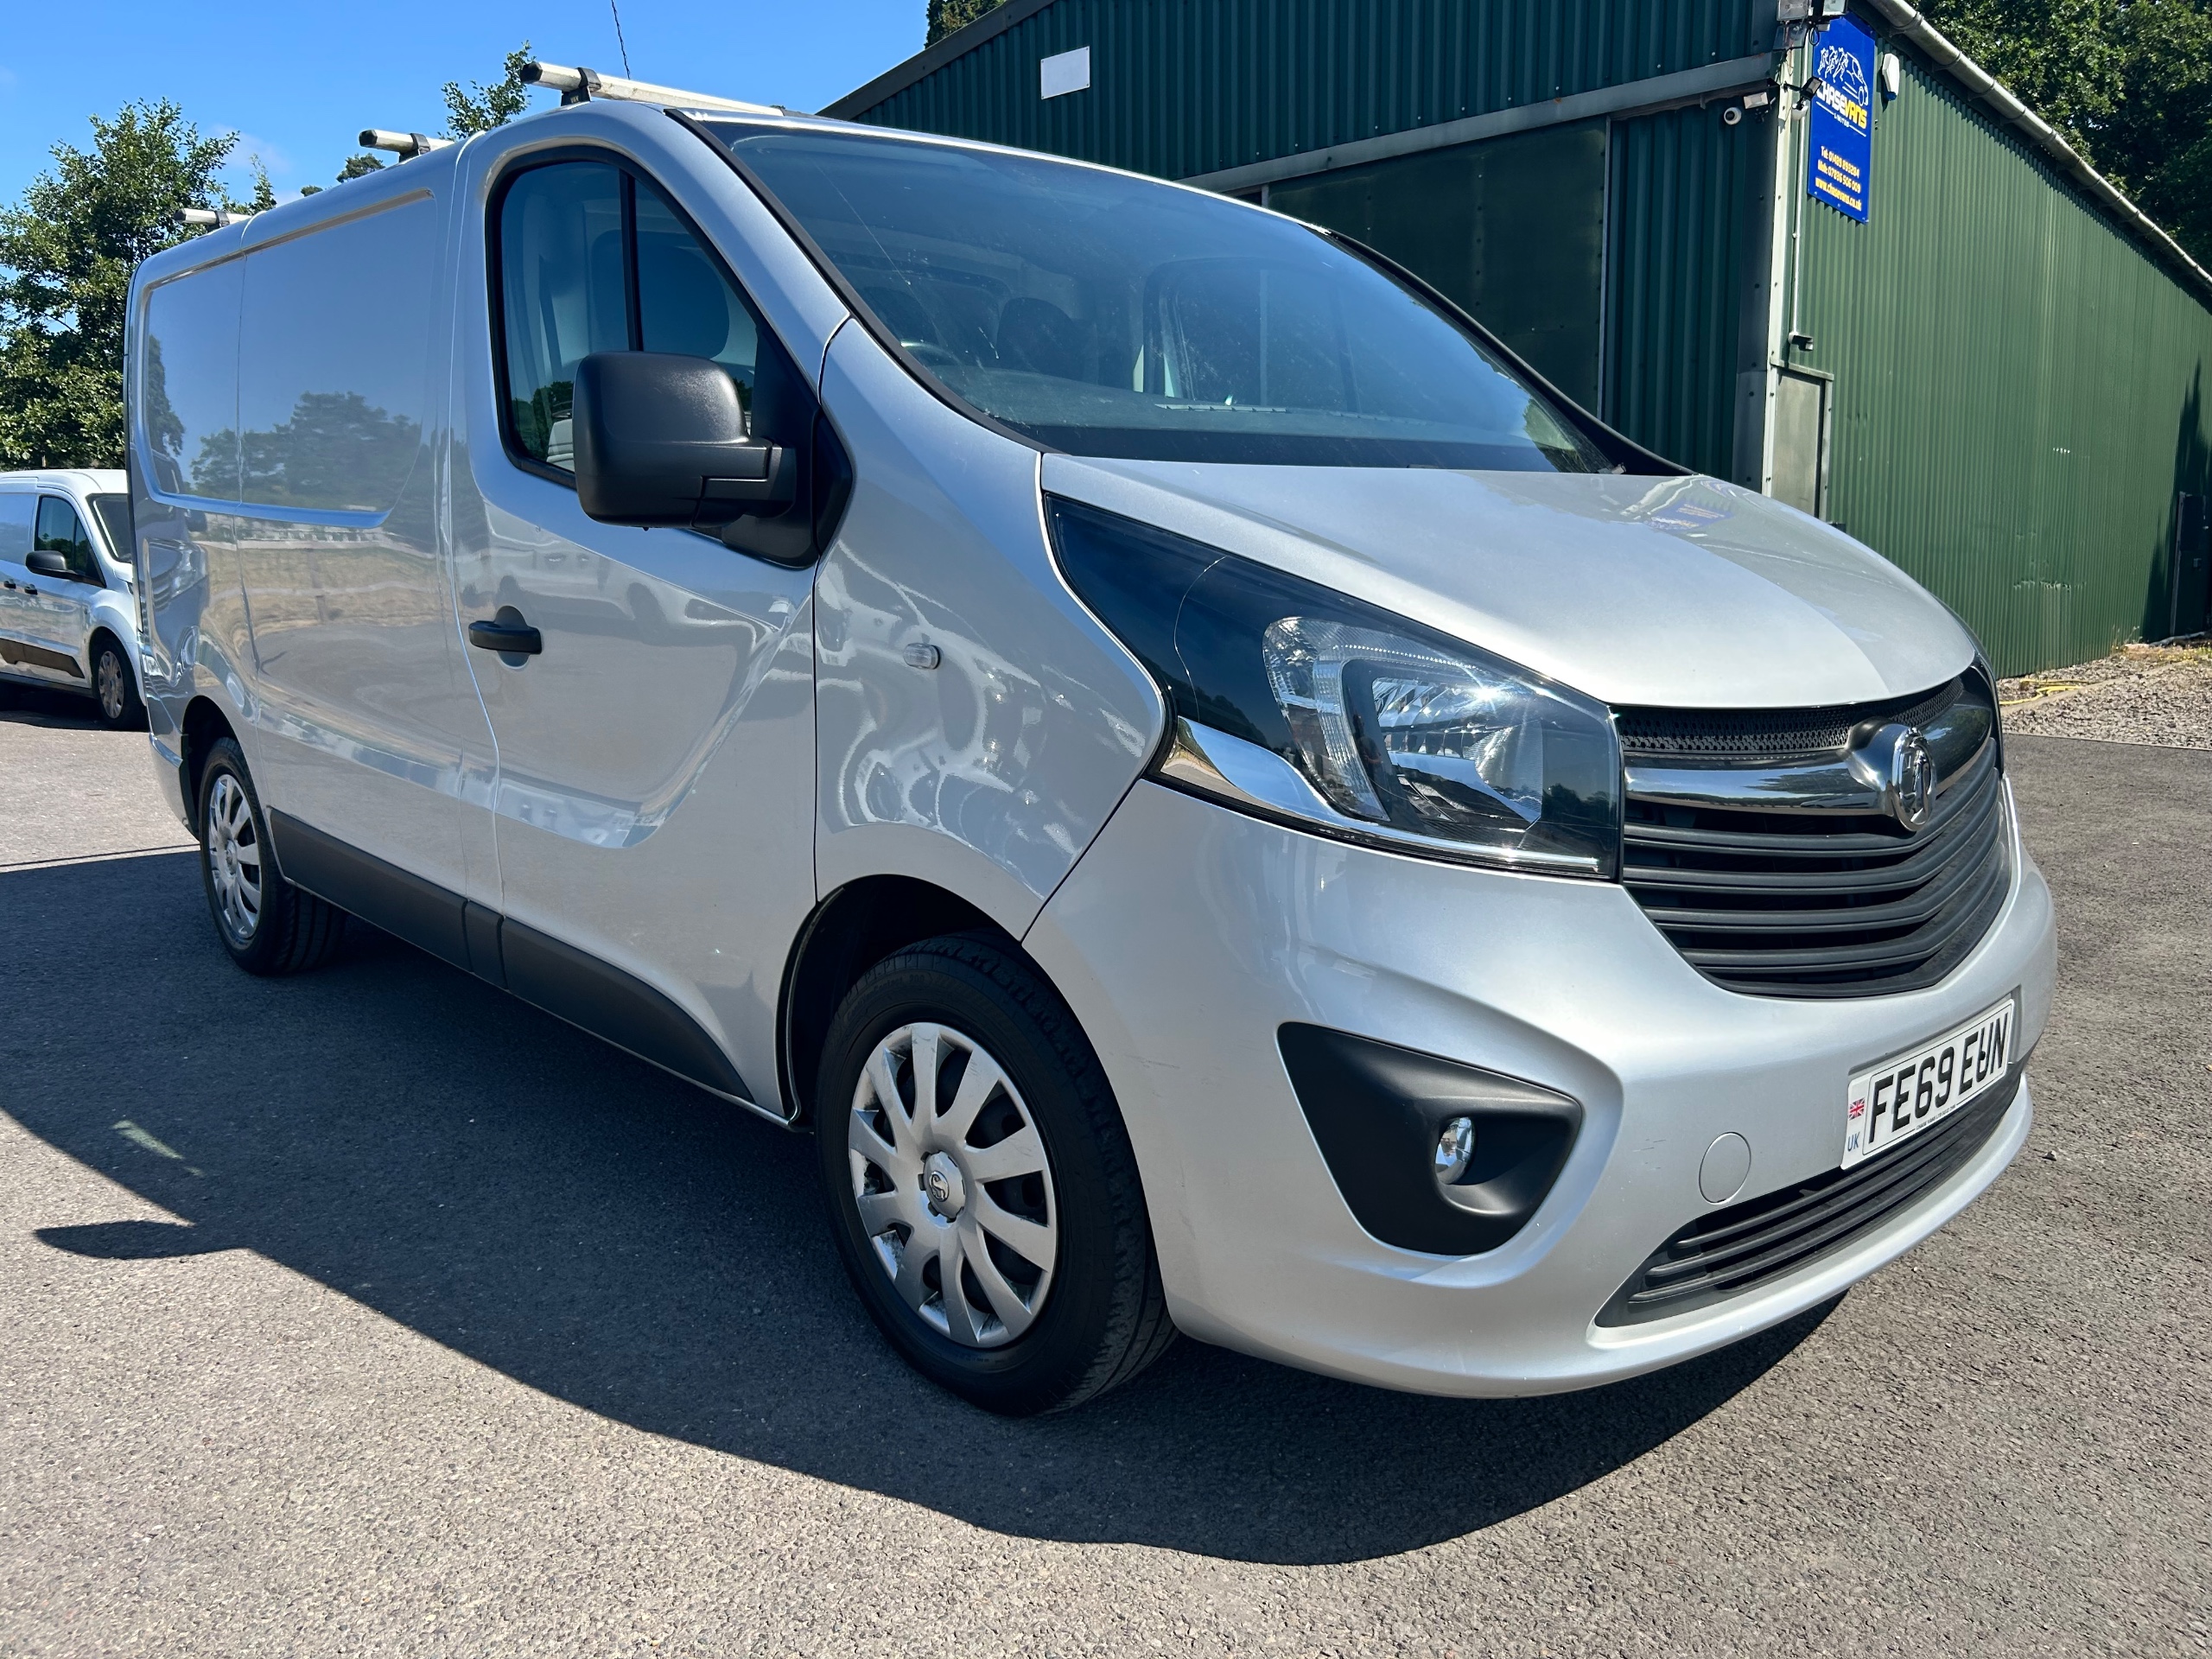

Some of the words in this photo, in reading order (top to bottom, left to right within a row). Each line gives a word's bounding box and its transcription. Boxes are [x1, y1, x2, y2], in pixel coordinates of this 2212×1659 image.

[1868, 1046, 1955, 1144] FE69
[1958, 1012, 2009, 1096] EUN
[1847, 1131, 1860, 1152] UK
